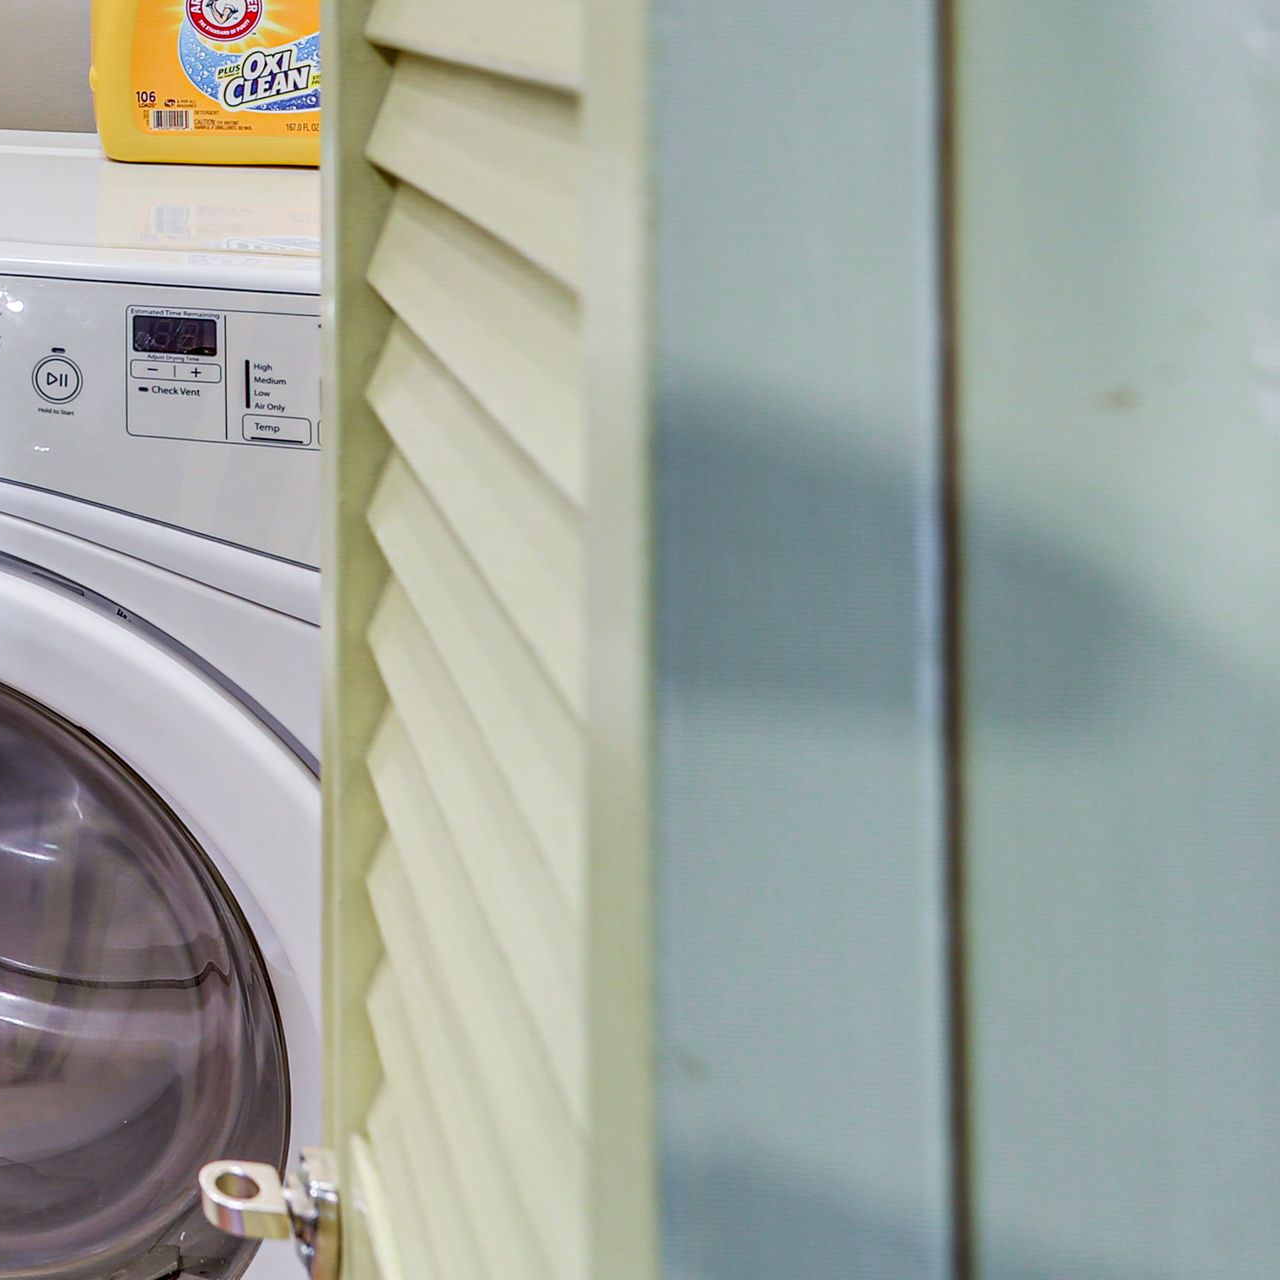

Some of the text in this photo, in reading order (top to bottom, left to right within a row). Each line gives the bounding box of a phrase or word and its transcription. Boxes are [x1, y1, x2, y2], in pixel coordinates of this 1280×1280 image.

[218, 64, 241, 76] PLUS
[242, 49, 293, 80] OXI
[224, 65, 311, 107] CLEAN
[136, 91, 156, 102] 106
[130, 308, 164, 316] Estimated
[183, 311, 220, 320] Remaining
[253, 363, 273, 372] High
[254, 376, 287, 385] Medium
[151, 385, 201, 397] Check Vent
[254, 389, 271, 397] Low
[254, 403, 286, 412] Air Only
[255, 423, 280, 434] Temp
